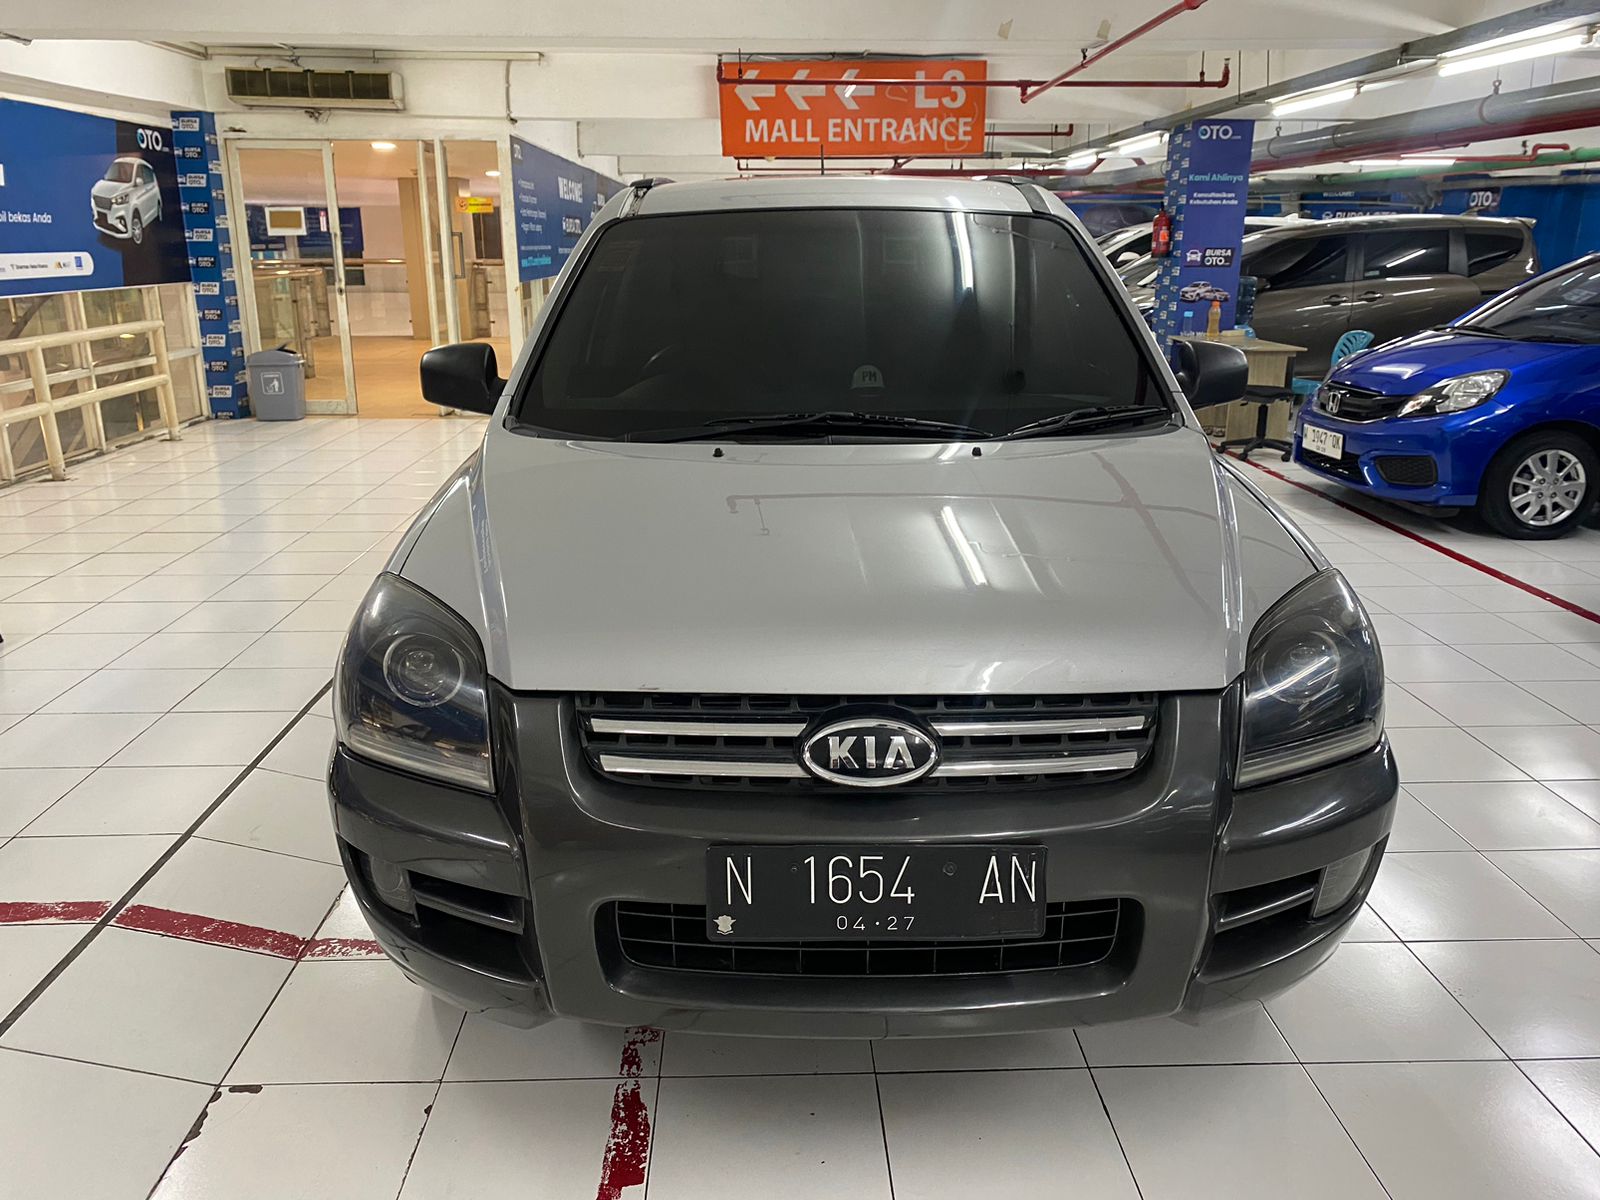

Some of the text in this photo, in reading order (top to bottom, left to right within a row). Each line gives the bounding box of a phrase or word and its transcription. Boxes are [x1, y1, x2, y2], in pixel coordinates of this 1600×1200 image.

[914, 69, 967, 109] L3
[136, 128, 162, 151] OTO
[745, 117, 972, 143] MALL ENTRANCE
[1198, 125, 1233, 140] OTO
[1189, 173, 1243, 183] Kami Ahlinya
[1470, 191, 1492, 206] OTO
[8, 211, 31, 223] bekas
[33, 212, 52, 223] Anda
[1205, 256, 1225, 265] OTO
[827, 735, 916, 770] KIA
[726, 855, 1037, 906] N 1654 AN
